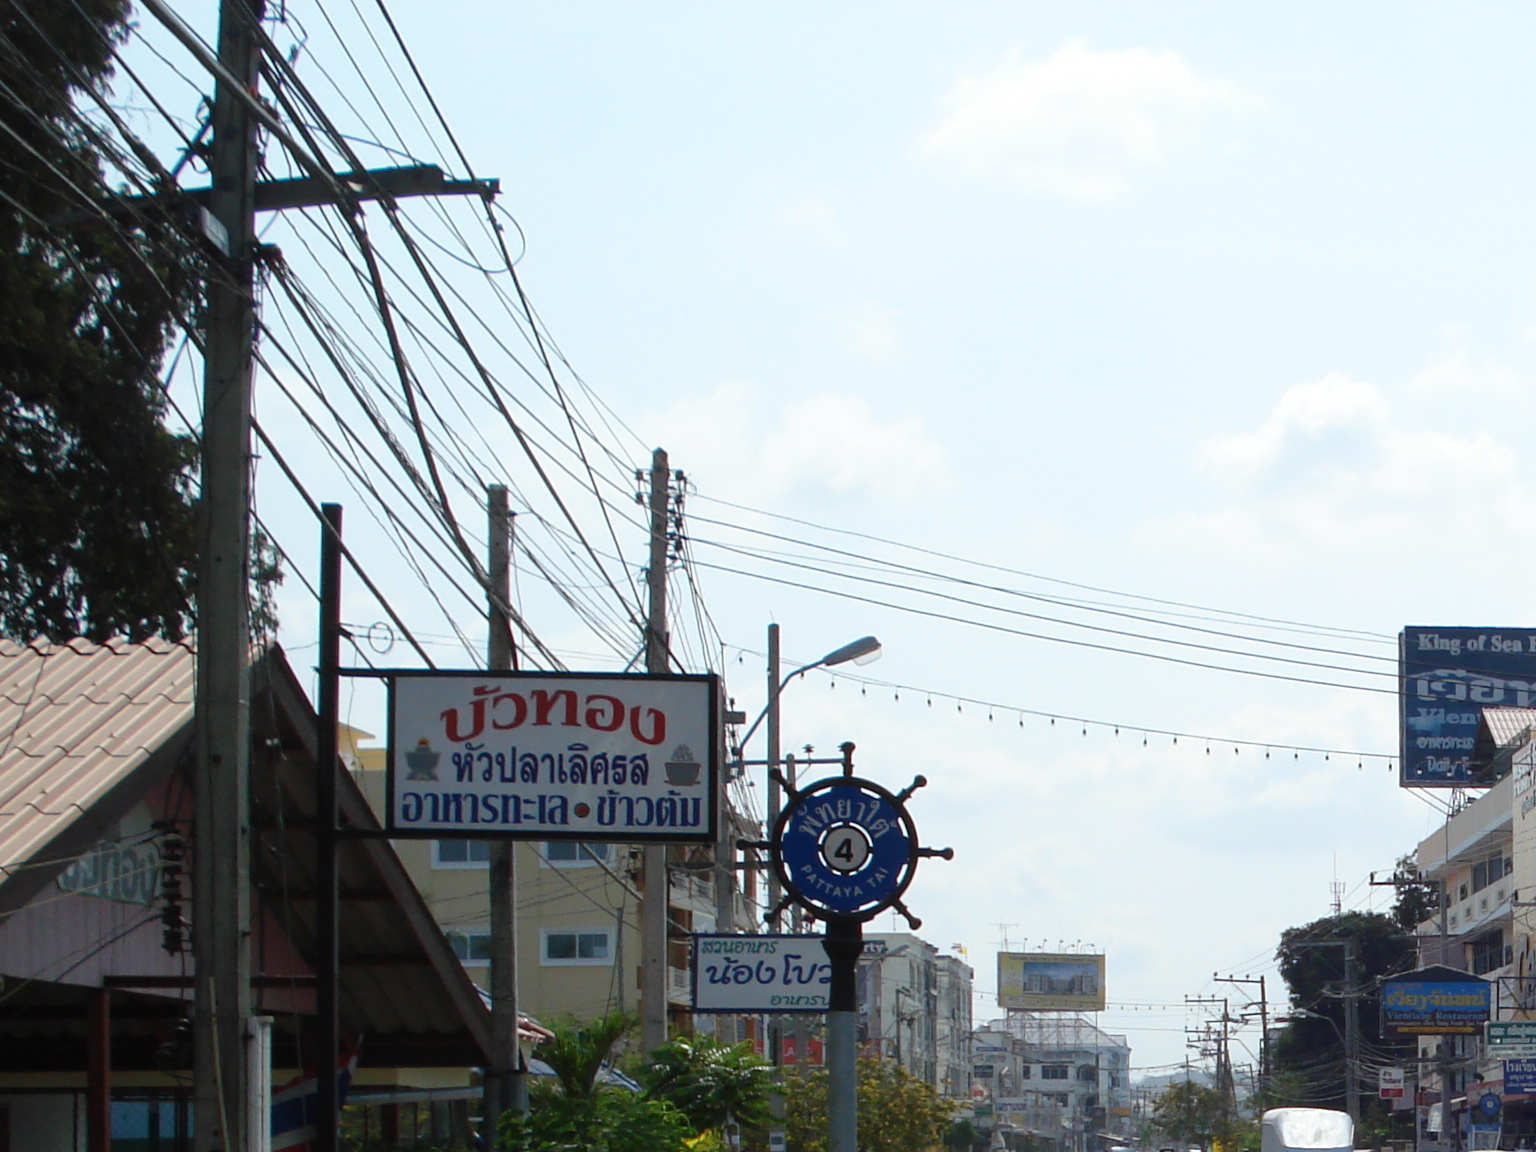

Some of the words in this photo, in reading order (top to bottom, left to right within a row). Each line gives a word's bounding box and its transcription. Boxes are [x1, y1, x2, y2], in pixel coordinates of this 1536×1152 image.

[1417, 633, 1462, 656] King
[1467, 634, 1487, 652] of
[1491, 635, 1523, 653] Sea
[440, 684, 666, 746] บัวทอง
[451, 741, 650, 787] หัวปลาเลิศรส
[401, 790, 570, 826] อาหารทะเล
[596, 789, 701, 828] ข้าวต้ม
[797, 799, 899, 840] พัทยาใต้
[834, 838, 854, 863] 4
[800, 865, 863, 897] PATTAYA
[868, 867, 889, 888] TAI
[701, 940, 779, 954] สวนอาหาร
